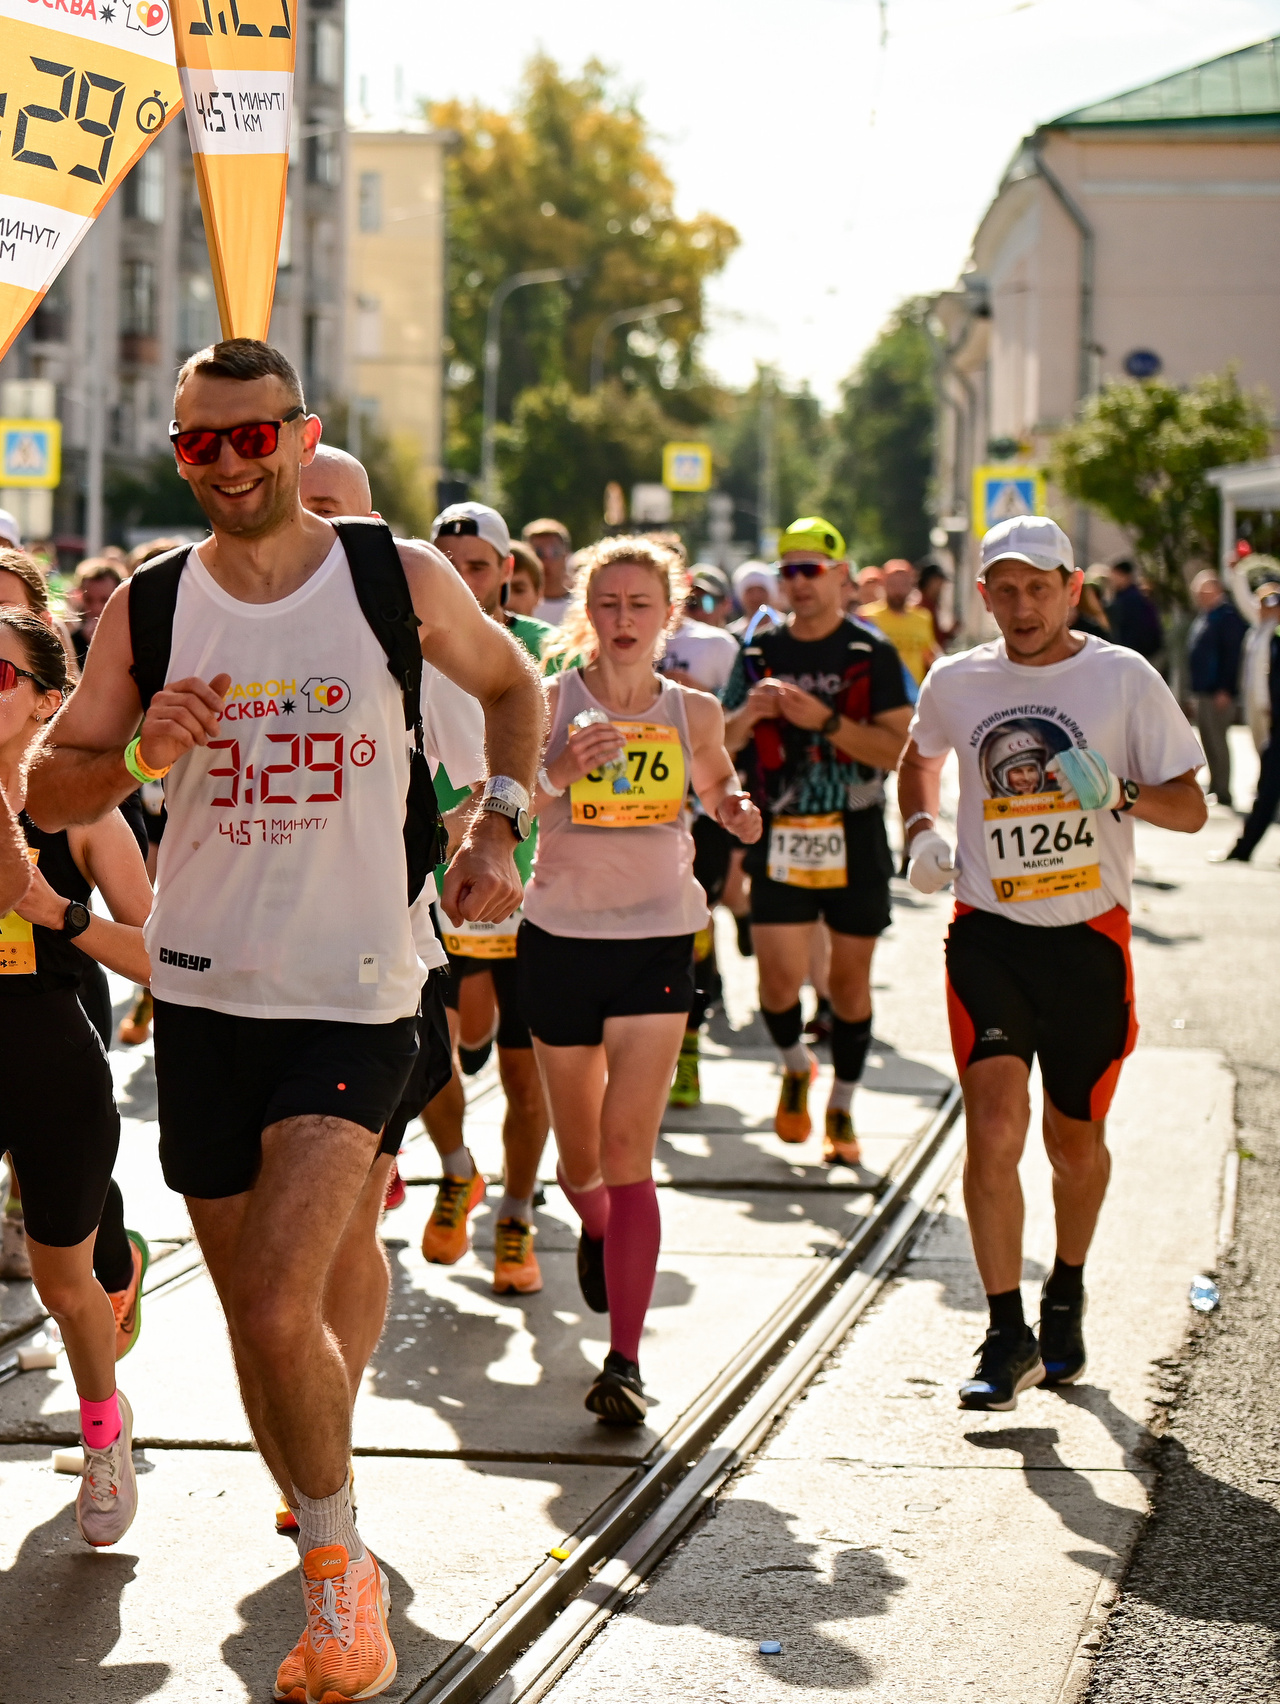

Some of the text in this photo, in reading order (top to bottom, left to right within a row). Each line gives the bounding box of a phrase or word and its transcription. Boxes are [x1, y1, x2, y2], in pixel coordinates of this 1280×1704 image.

[194, 91, 239, 133] 4:57
[242, 115, 263, 133] КМ
[217, 699, 280, 723] СКВА
[970, 705, 1058, 748] АСТРОНОМИЧЕСКИЙ
[206, 733, 344, 808] 3:29
[583, 804, 597, 819] D
[219, 818, 328, 845] 4:57 МИНУТ/
[271, 833, 292, 845] КМ
[990, 817, 1095, 859] 11264
[1023, 856, 1064, 869] МАКСИМ
[1001, 880, 1014, 898] D
[159, 946, 212, 973] СИБУР
